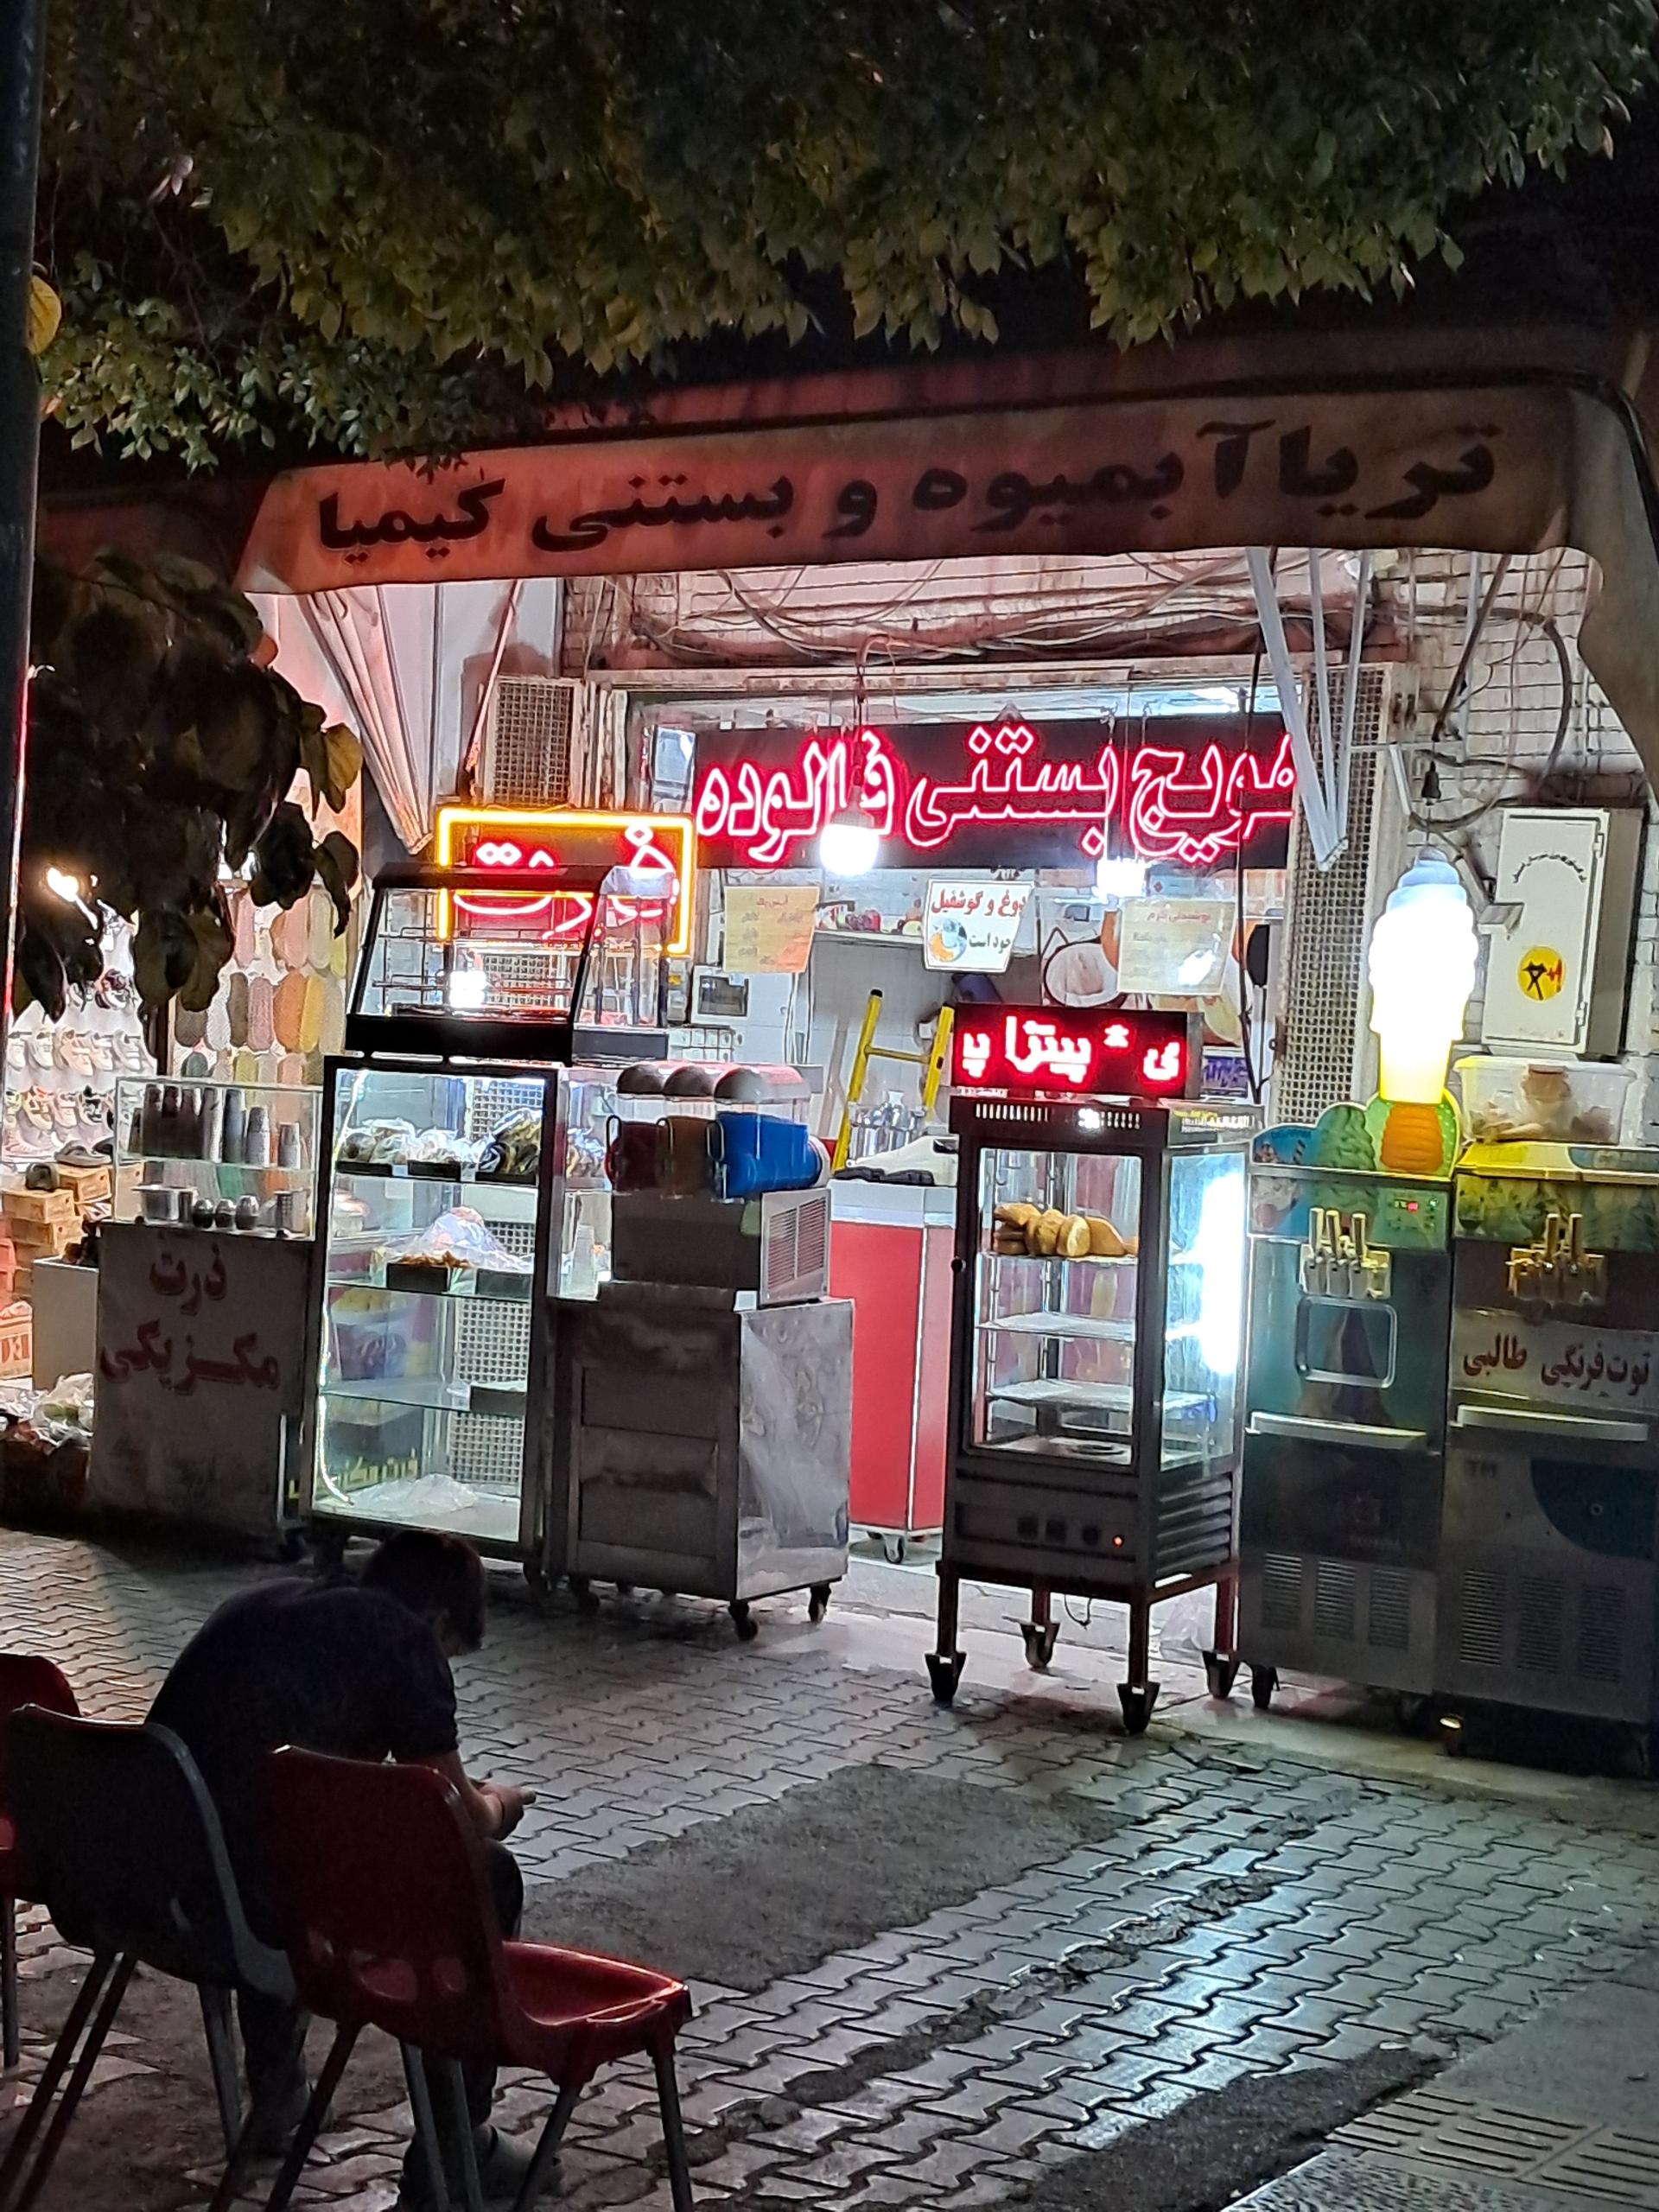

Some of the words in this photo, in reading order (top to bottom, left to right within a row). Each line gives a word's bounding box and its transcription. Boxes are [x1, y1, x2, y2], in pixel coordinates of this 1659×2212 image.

[318, 478, 505, 563] کیمیا
[531, 473, 794, 552] بستنی
[822, 479, 877, 537] و
[696, 731, 894, 862] فالوده
[906, 726, 1118, 855] بستنی
[931, 888, 983, 915] گوشفیل
[983, 899, 995, 916] و
[149, 1240, 226, 1316] ذرت
[99, 1319, 281, 1395] مکزیکی
[1463, 1332, 1528, 1376] طالبی
